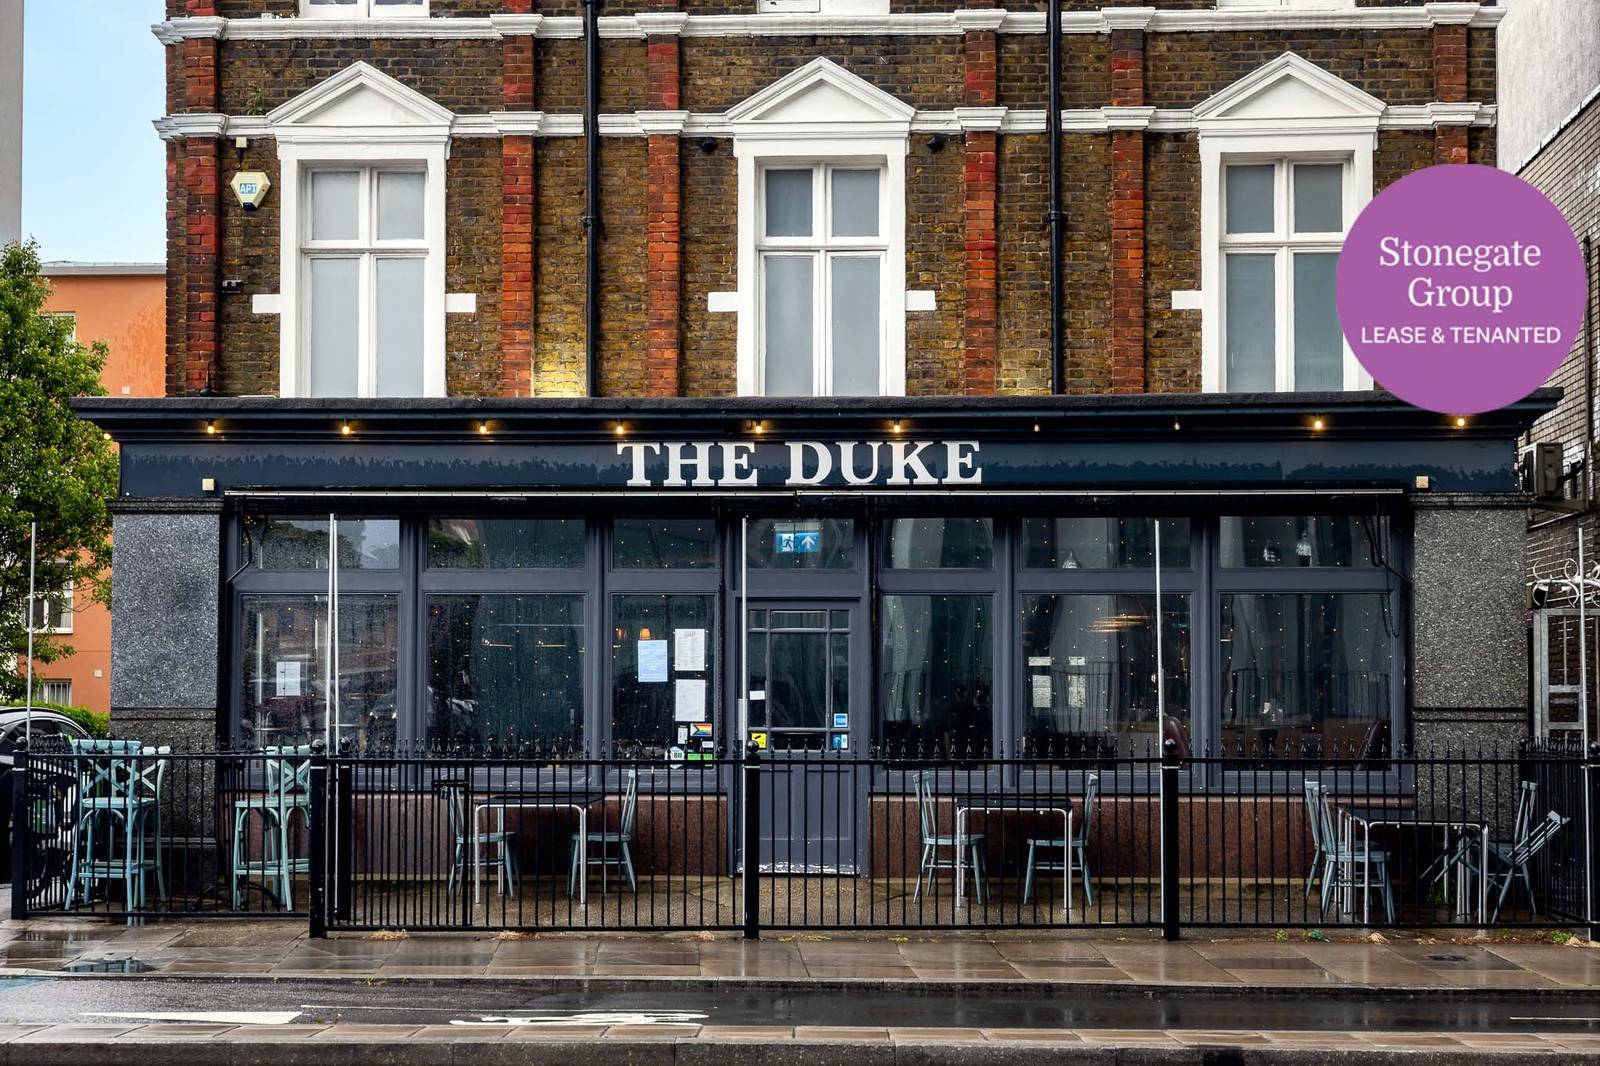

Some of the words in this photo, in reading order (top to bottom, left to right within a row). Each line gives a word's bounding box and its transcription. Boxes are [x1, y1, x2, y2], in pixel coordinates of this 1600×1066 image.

[240, 183, 256, 194] APT
[617, 441, 758, 487] THE
[785, 440, 982, 486] DUKE
